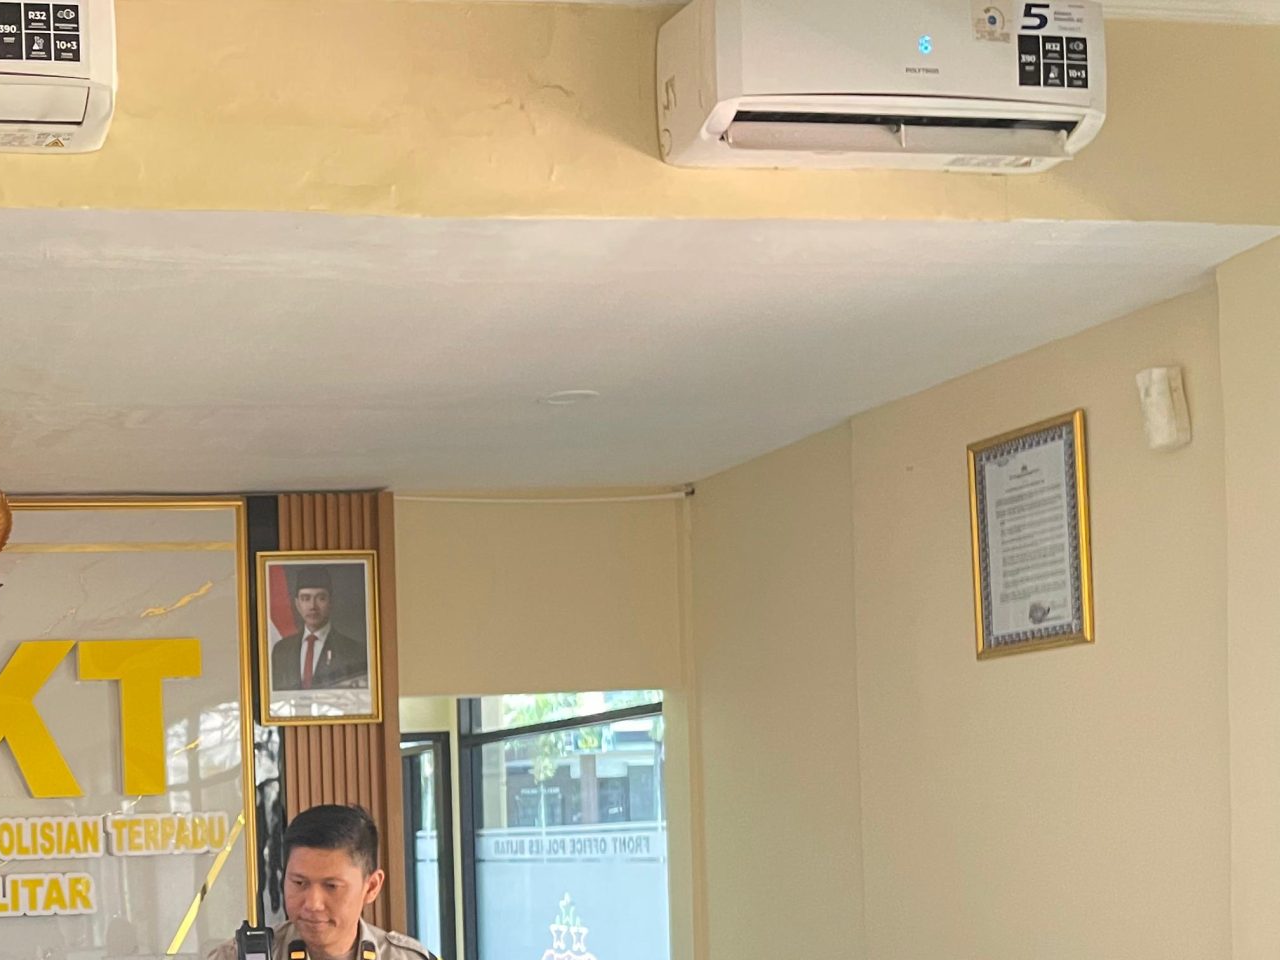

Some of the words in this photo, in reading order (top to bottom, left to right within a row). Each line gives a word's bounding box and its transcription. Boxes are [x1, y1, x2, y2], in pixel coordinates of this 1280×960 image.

[28, 11, 46, 20] R32
[1020, 3, 1050, 30] 5
[55, 40, 77, 50] 10+3
[112, 813, 228, 853] TERPADU
